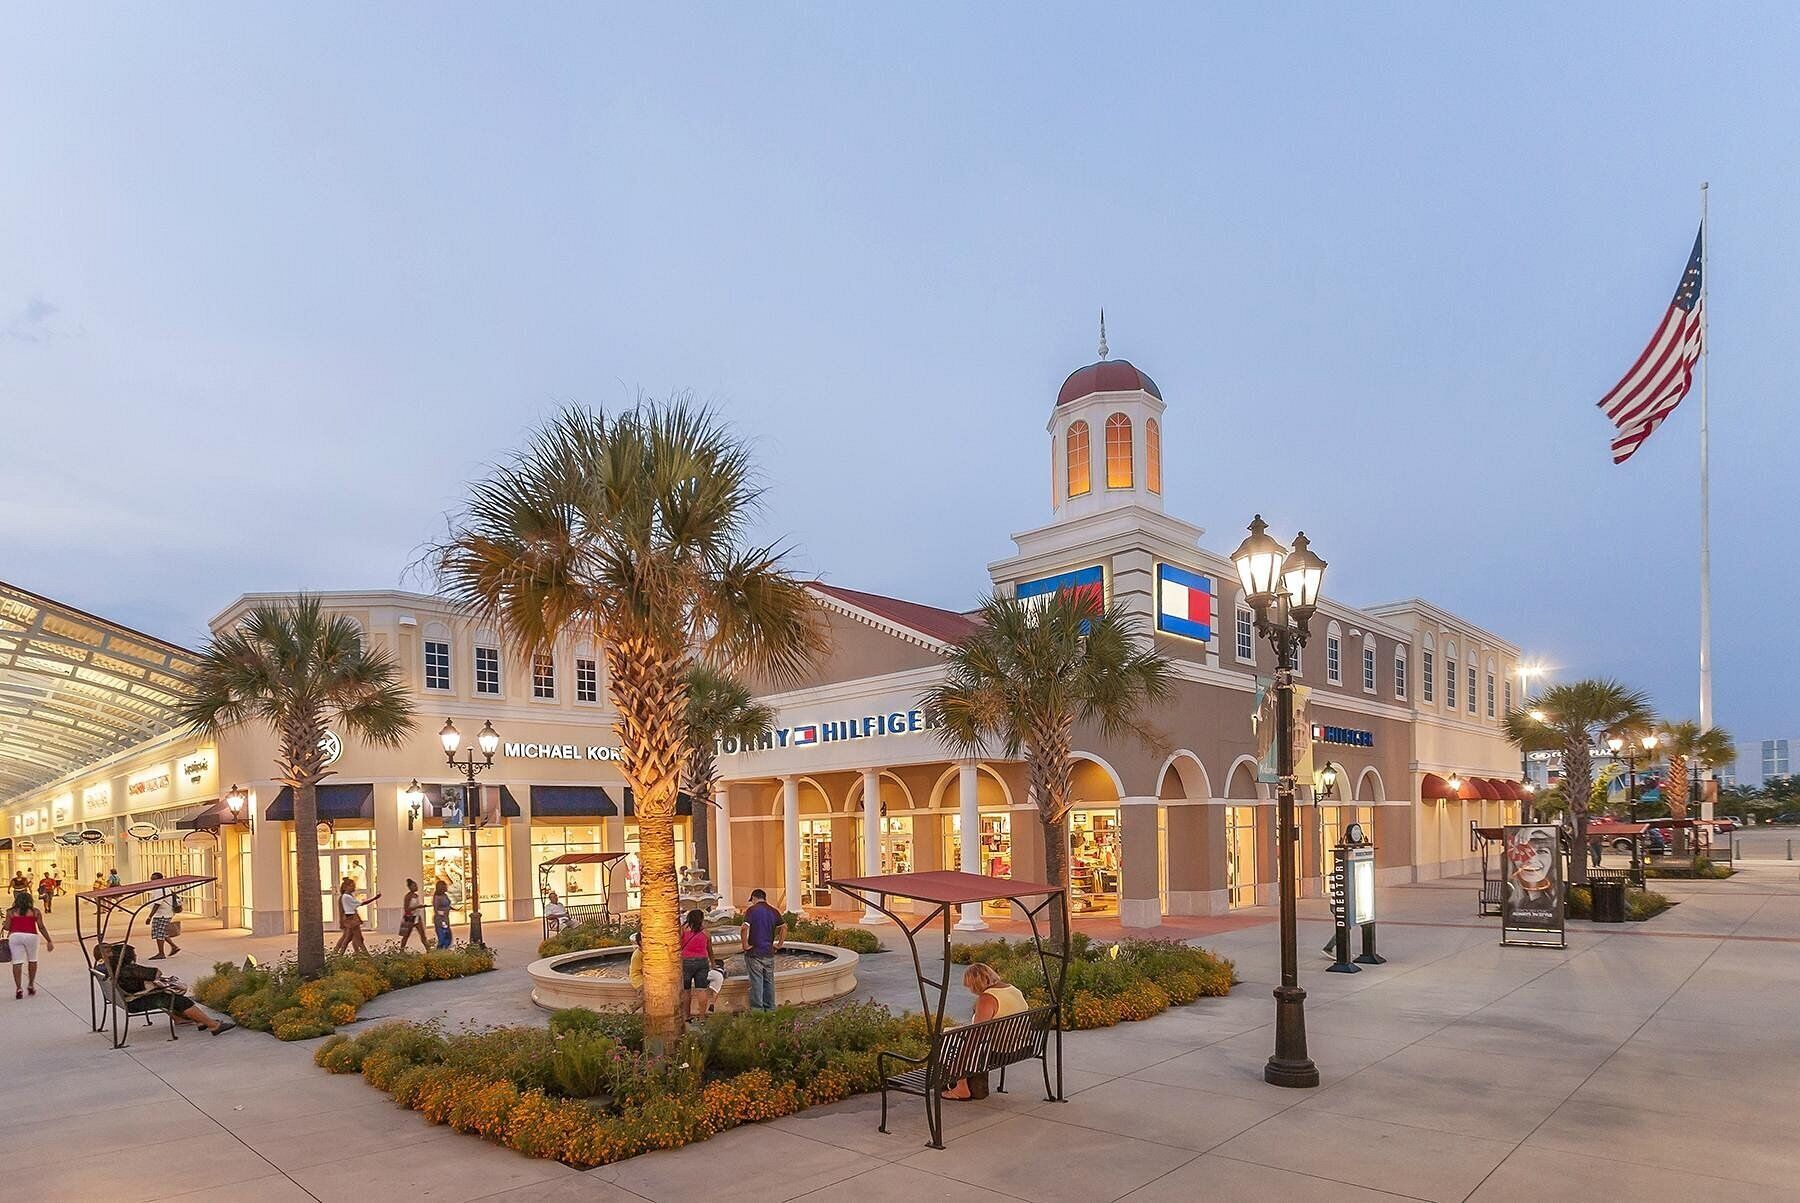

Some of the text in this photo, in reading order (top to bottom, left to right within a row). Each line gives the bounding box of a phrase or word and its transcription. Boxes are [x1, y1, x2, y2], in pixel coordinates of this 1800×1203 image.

[504, 742, 622, 761] MICHAEL KOR
[1335, 858, 1346, 927] DIRECTORY
